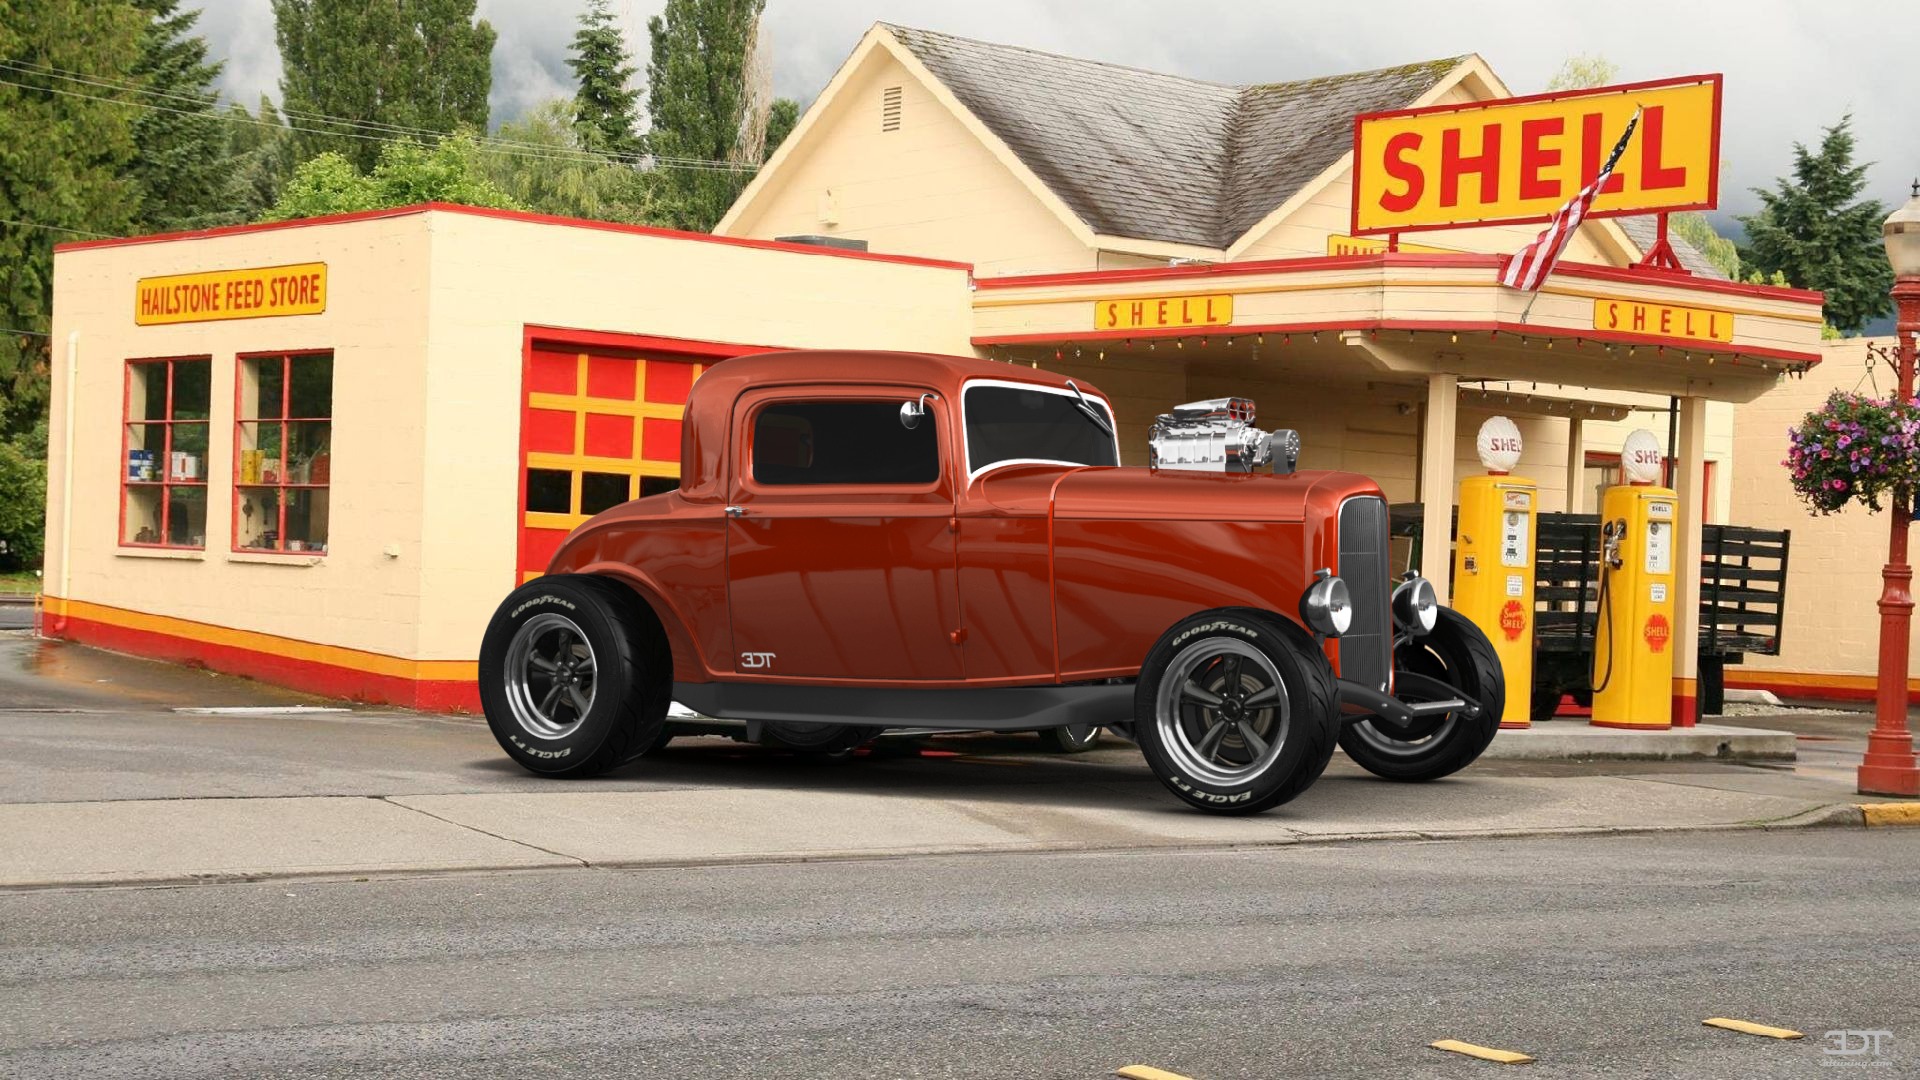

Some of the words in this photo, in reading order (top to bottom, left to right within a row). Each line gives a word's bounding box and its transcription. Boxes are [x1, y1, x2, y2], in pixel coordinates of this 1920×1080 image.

[1378, 105, 1687, 213] SHELL
[141, 283, 221, 316] HAILSTONE
[225, 279, 264, 311] FEED
[269, 274, 321, 307] STORE
[1108, 299, 1217, 327] SHELL
[1609, 303, 1719, 338] SHELL
[511, 595, 576, 618] GOODYEAR
[1172, 621, 1258, 647] GOODYEAR
[1646, 626, 1668, 637] SHELL
[741, 652, 776, 668] 3DT
[526, 747, 572, 759] EAGLE
[1170, 776, 1190, 792] F1
[1193, 790, 1253, 803] EAGLE
